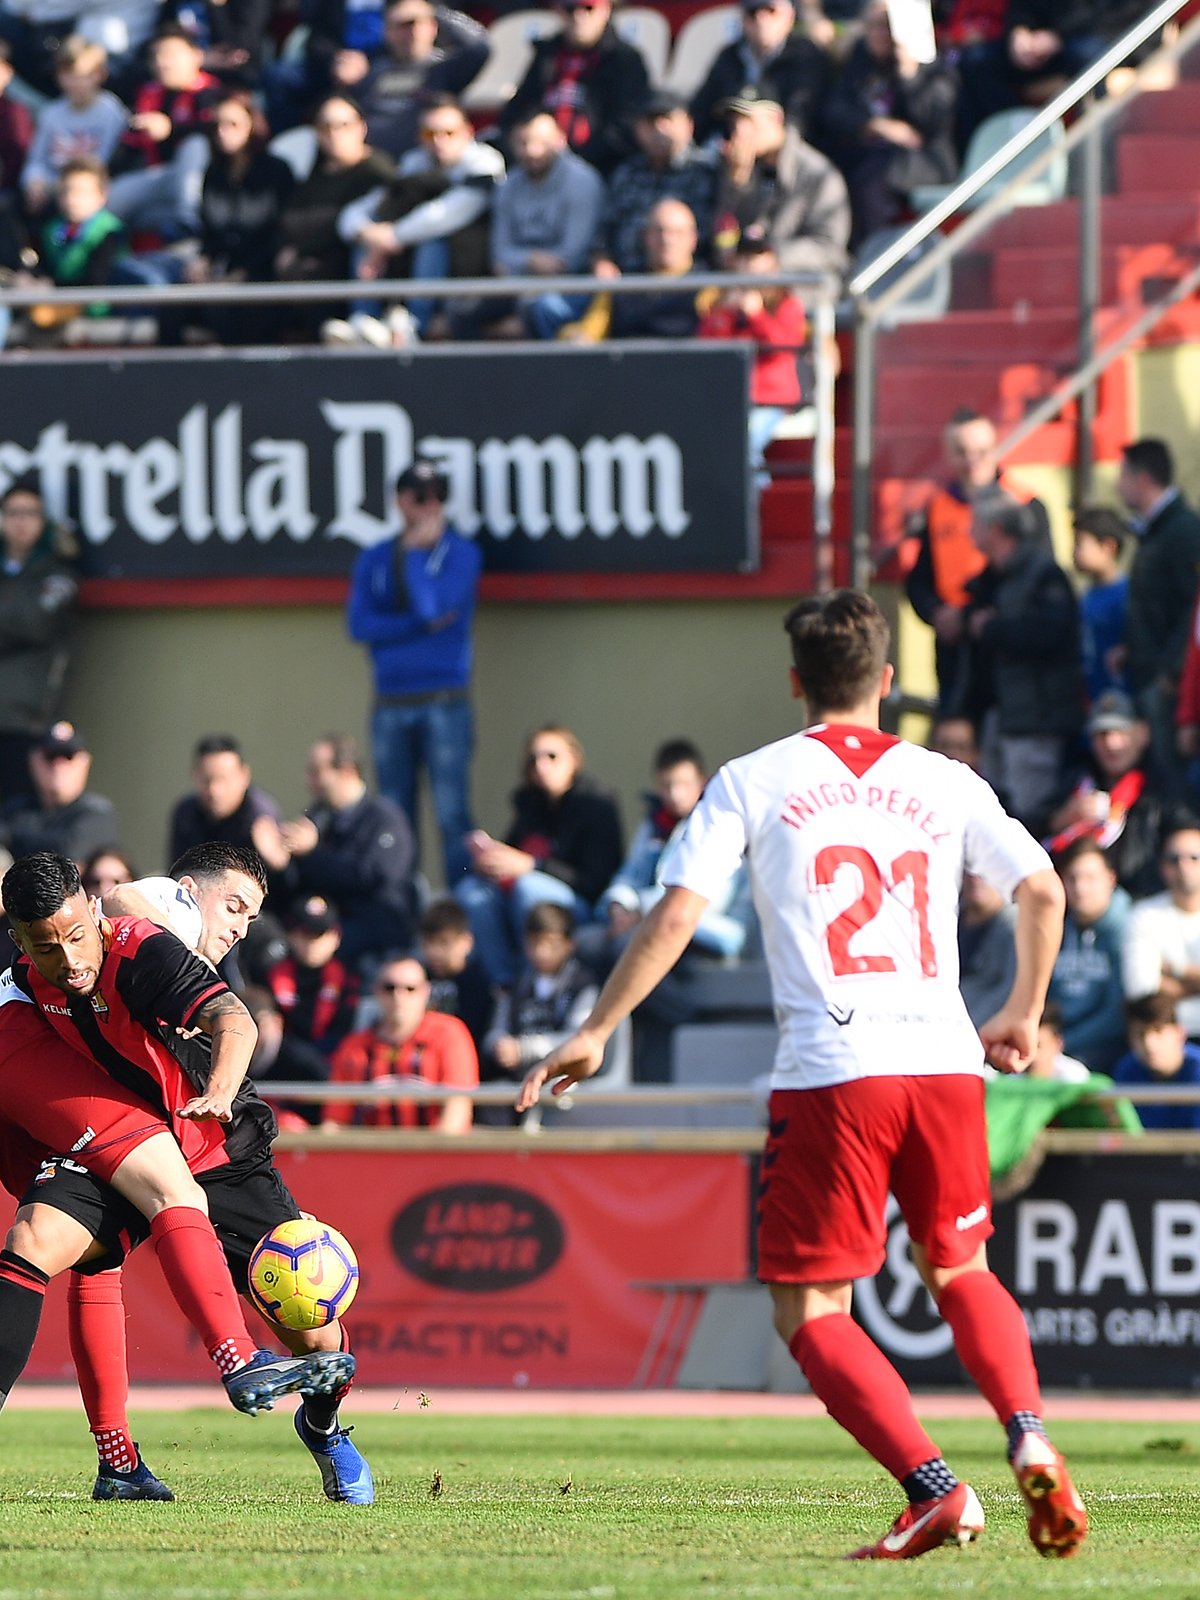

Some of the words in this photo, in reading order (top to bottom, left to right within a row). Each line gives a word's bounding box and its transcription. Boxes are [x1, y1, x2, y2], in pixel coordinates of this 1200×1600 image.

[319, 398, 691, 549] Damm
[812, 844, 939, 981] 21
[42, 1003, 73, 1017] KELME
[1014, 1199, 1200, 1295] RAB
[353, 1322, 569, 1358] RACTION
